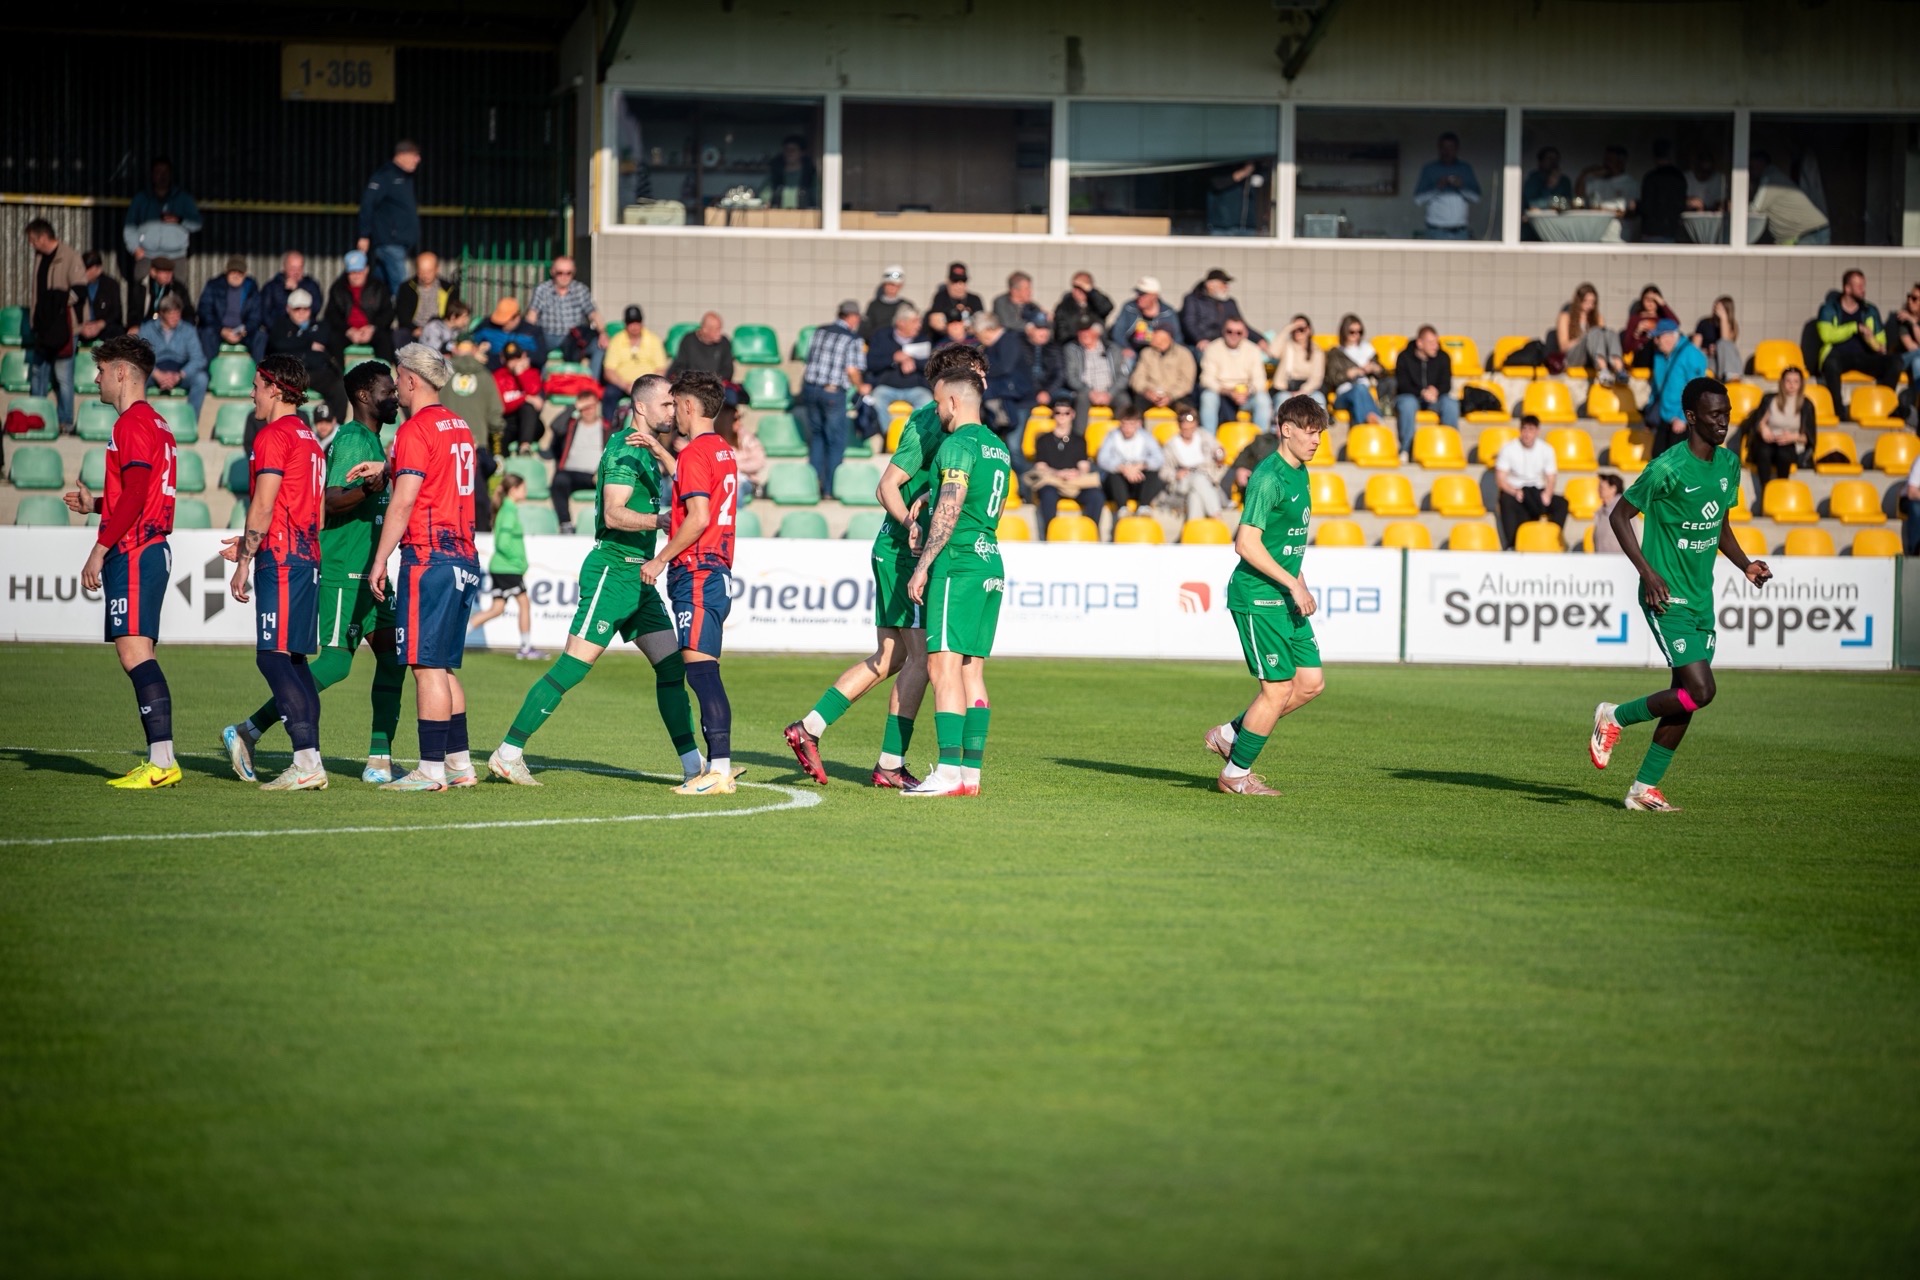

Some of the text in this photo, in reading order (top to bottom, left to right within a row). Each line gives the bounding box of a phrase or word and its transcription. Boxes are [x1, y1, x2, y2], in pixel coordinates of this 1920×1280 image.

[299, 58, 373, 88] 1-366
[450, 443, 475, 496] 13
[986, 469, 1005, 518] 8
[1007, 578, 1139, 614] tampa
[1478, 573, 1614, 597] Aluminium
[1721, 577, 1859, 601] Aluminium
[110, 597, 128, 615] 20
[261, 612, 277, 629] 14
[677, 610, 692, 629] 22
[1444, 588, 1611, 642] Sappex
[1718, 604, 1856, 647] appex
